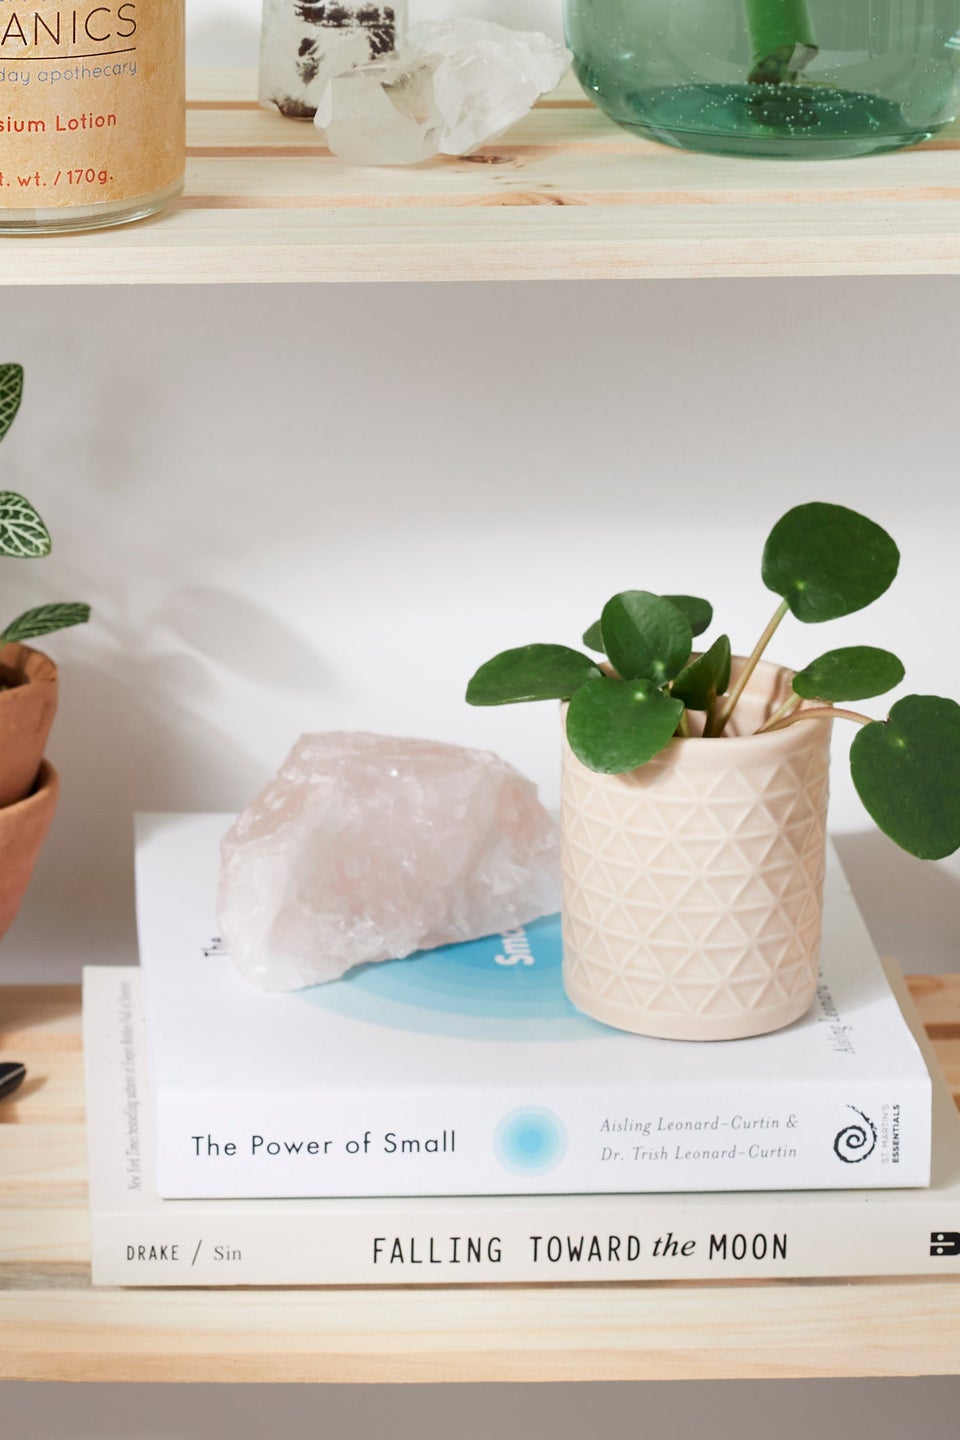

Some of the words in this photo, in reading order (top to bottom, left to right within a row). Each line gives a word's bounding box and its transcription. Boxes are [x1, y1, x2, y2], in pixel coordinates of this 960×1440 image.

[37, 60, 137, 85] apothecary
[56, 112, 117, 132] Lotion
[17, 172, 47, 187] wt.
[67, 168, 114, 185] 170g.
[600, 1118, 652, 1136] Aisling
[657, 1115, 780, 1131] Leonard-Curtin
[785, 1114, 798, 1129] &
[892, 1104, 900, 1164] ESSENTIALS
[191, 1134, 237, 1156] The
[251, 1135, 333, 1156] Power
[345, 1131, 371, 1154] of
[383, 1130, 455, 1153] Small
[601, 1147, 624, 1161] Dr.
[633, 1145, 669, 1161] Trish
[675, 1144, 798, 1160] Leonard-Curtin
[126, 1244, 180, 1262] DRAKE
[214, 1244, 243, 1261] Sin
[373, 1236, 503, 1264] FALLING
[529, 1235, 641, 1262] TOWARD
[652, 1232, 696, 1257] the
[709, 1233, 788, 1261] MOON
